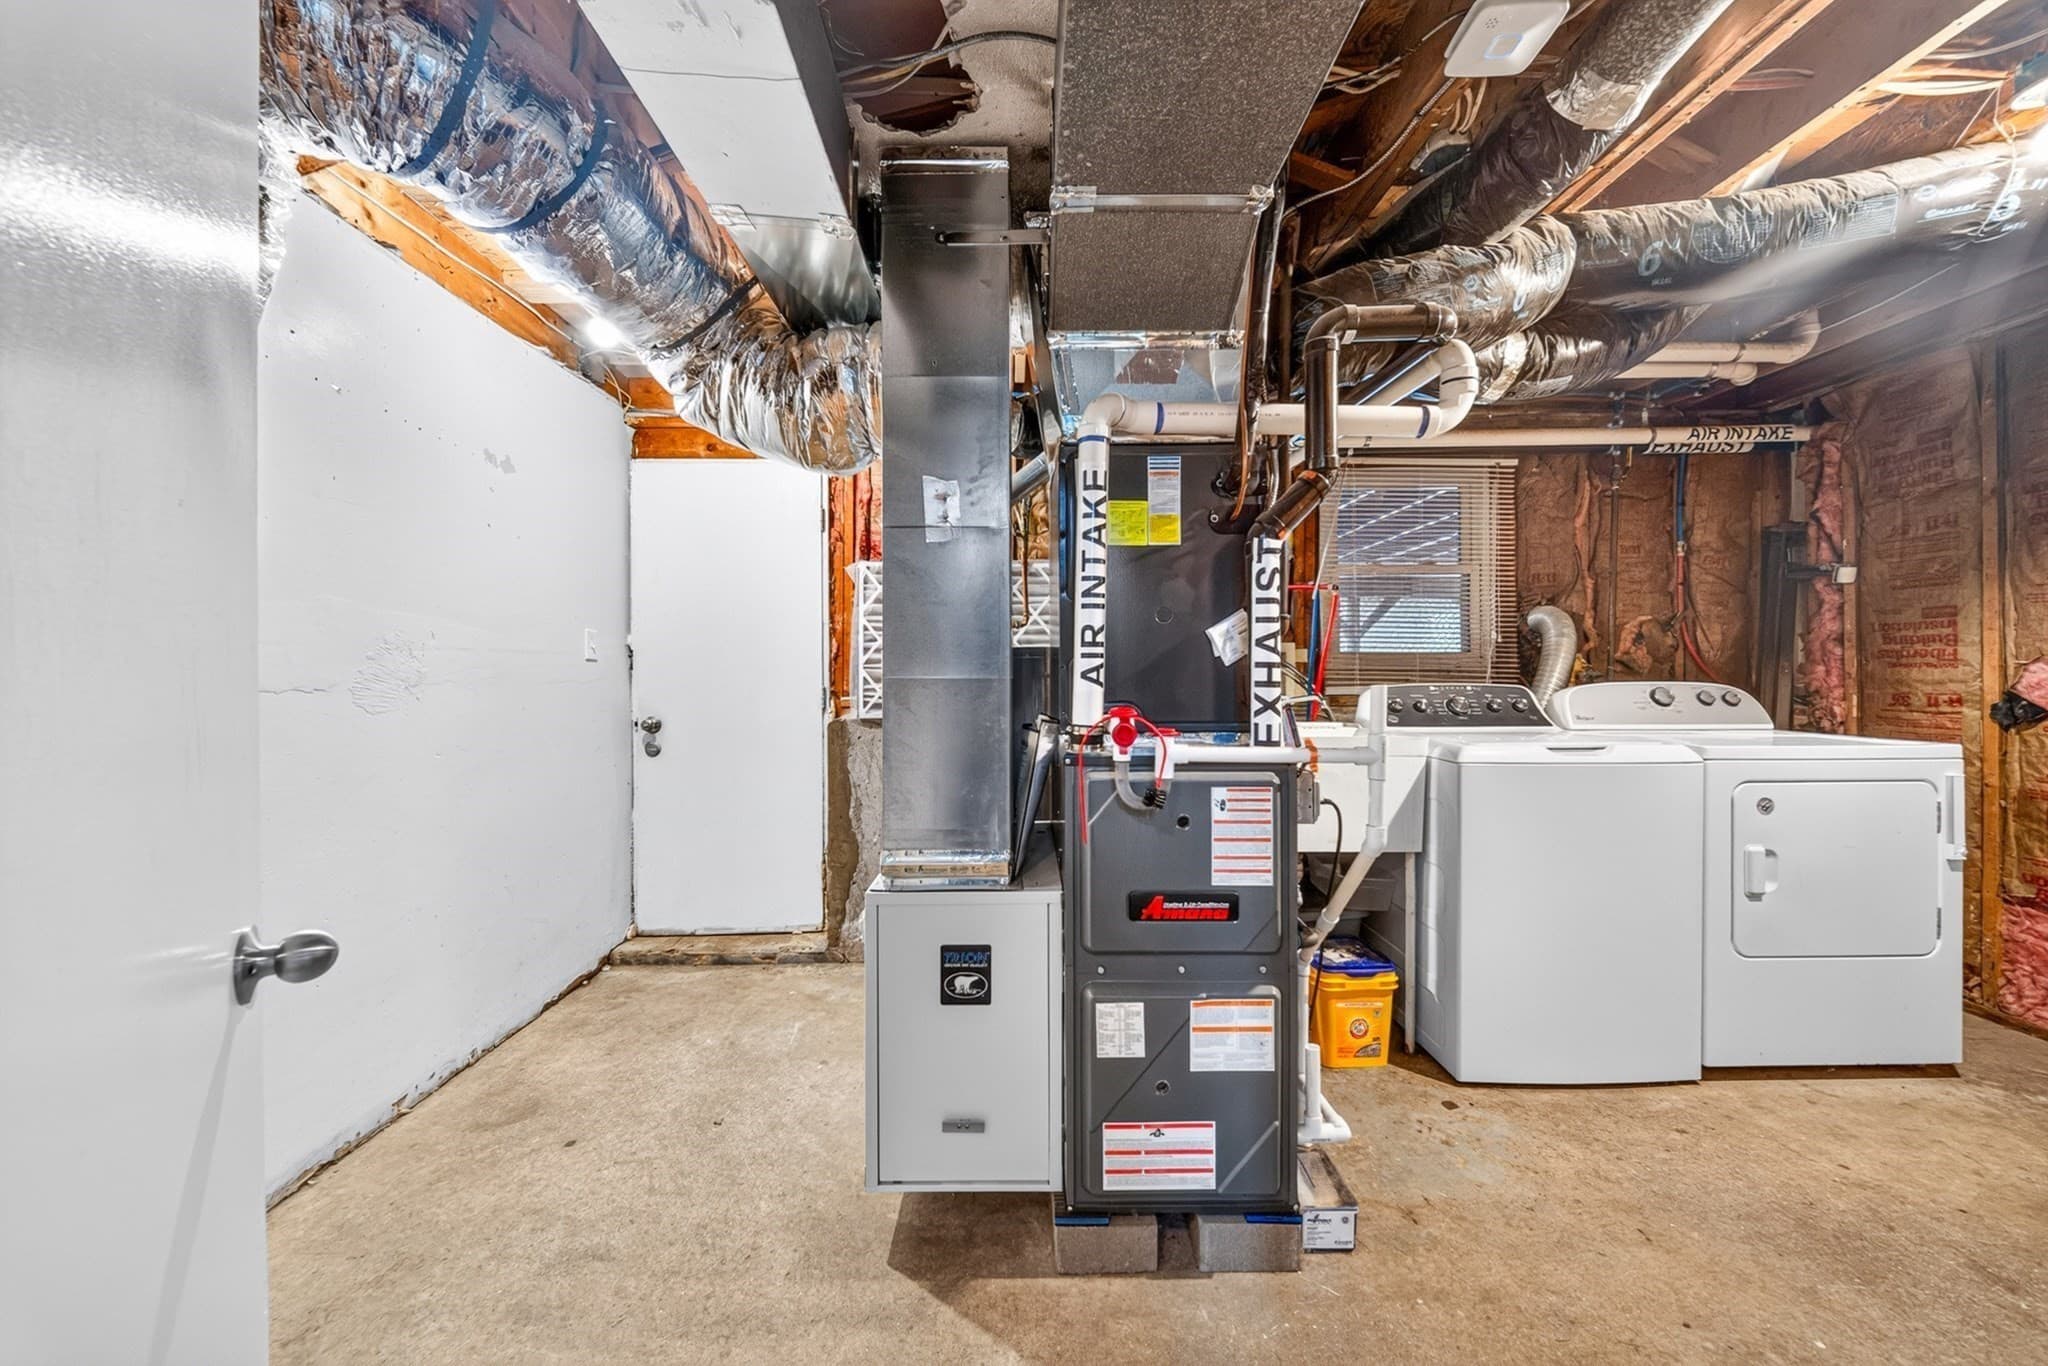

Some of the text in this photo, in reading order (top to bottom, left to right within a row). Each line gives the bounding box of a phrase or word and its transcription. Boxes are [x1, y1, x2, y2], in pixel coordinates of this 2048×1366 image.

[1652, 442, 1746, 453] EXHAUST
[1687, 426, 1794, 441] AIR INTAKE
[1080, 469, 1108, 689] AIR INTAKE
[1254, 537, 1282, 747] EXHAUST
